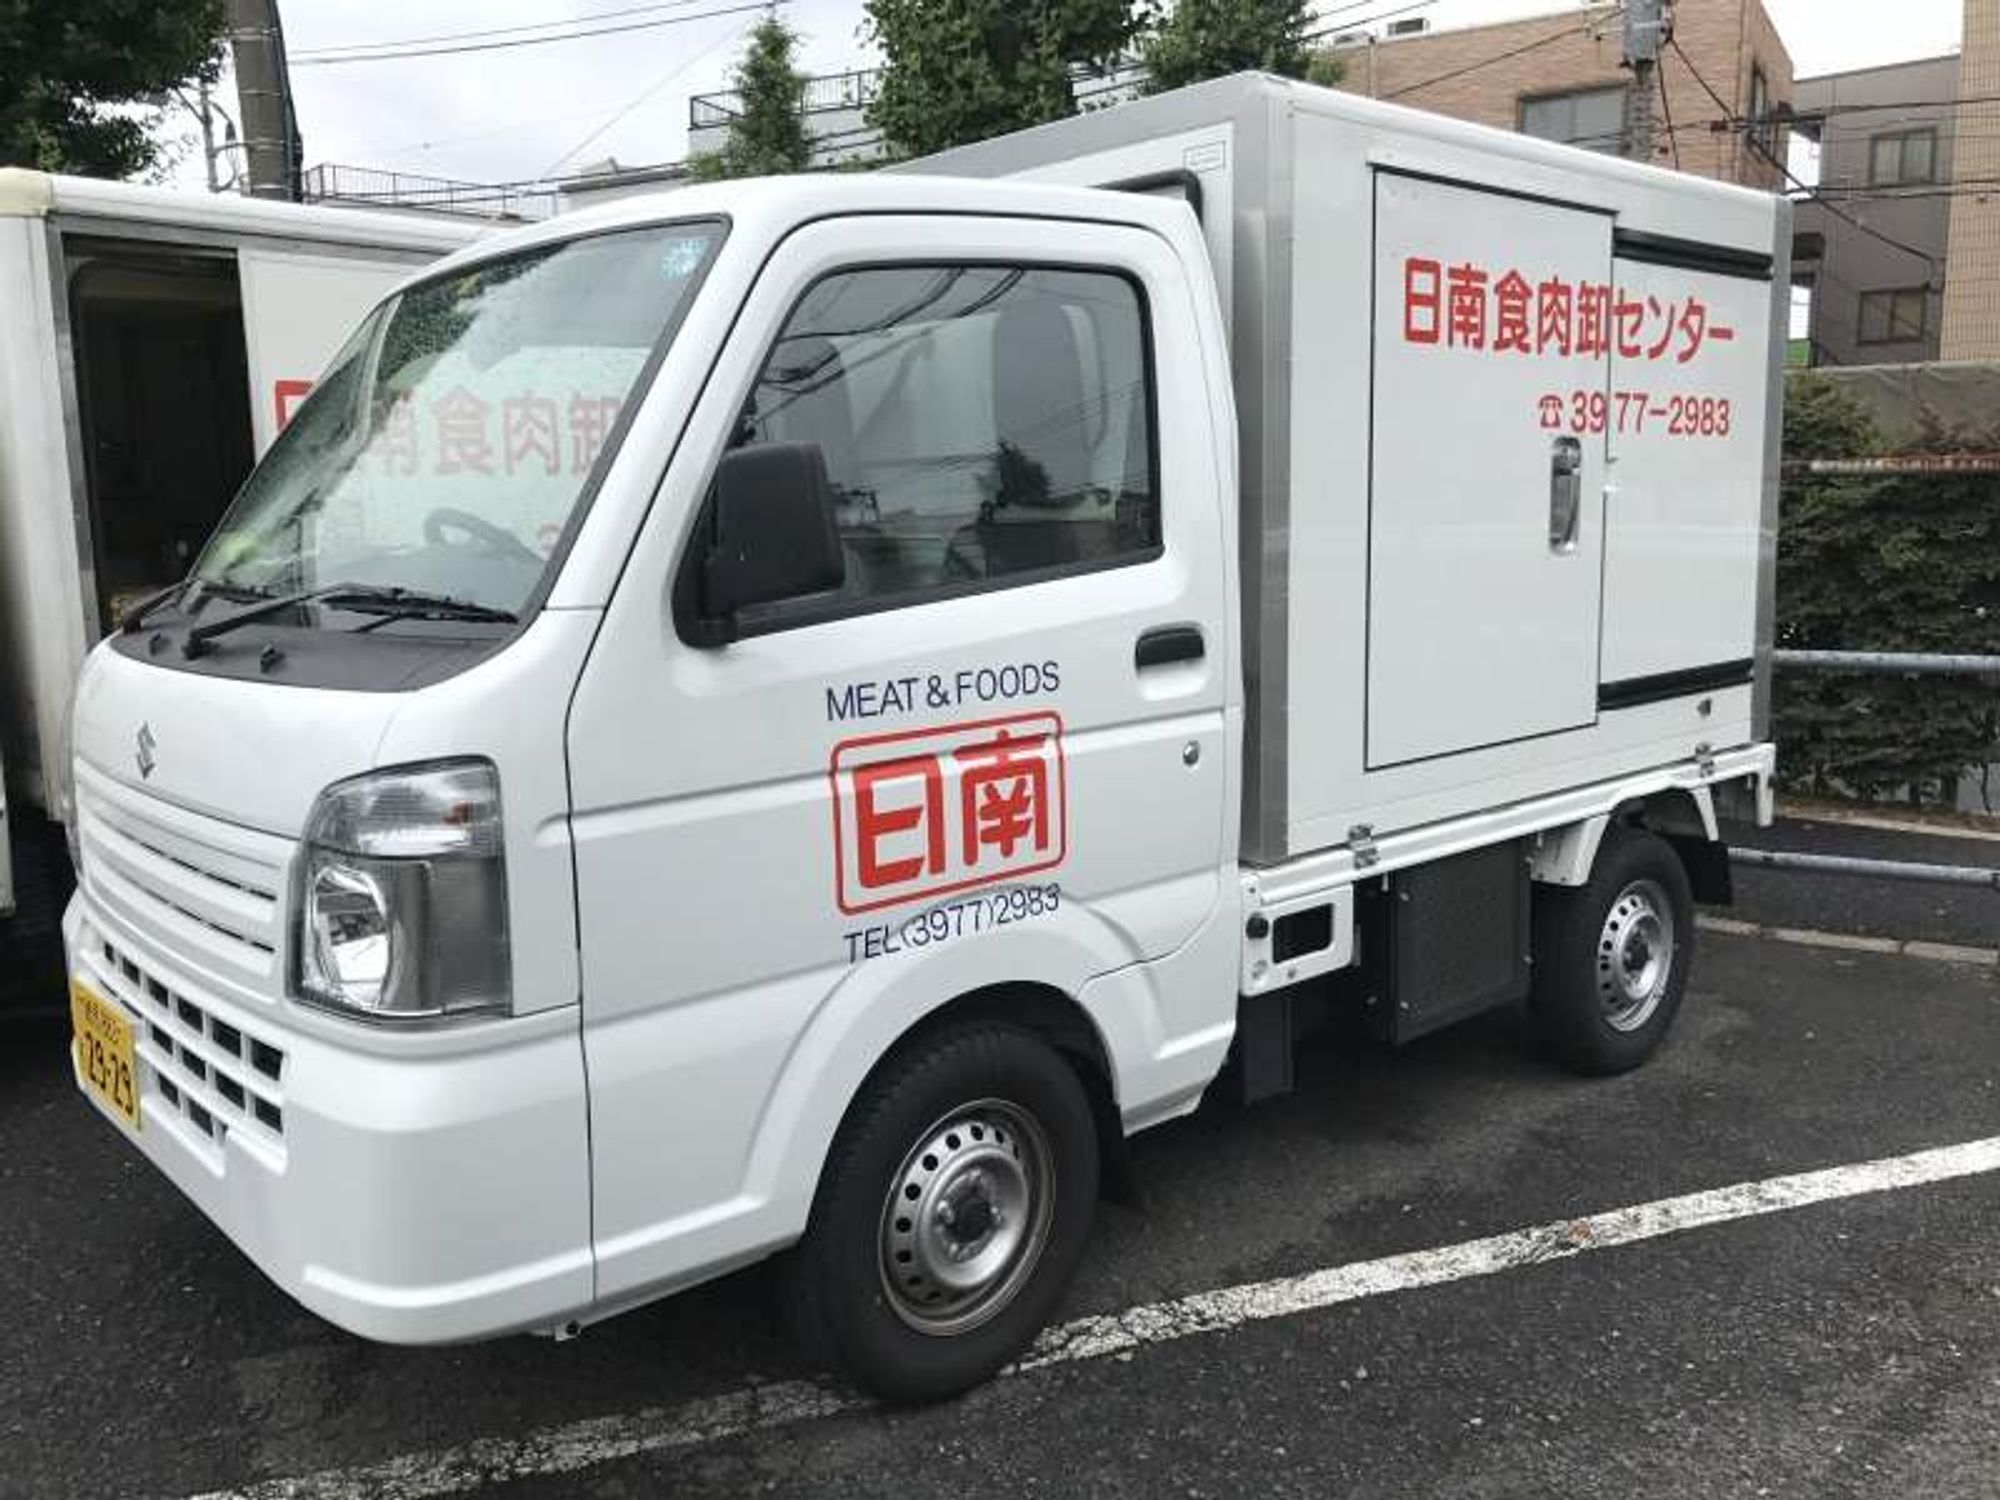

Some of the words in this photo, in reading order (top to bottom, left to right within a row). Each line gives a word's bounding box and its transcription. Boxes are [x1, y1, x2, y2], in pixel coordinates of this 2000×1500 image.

[1404, 257, 1734, 363] 日南食肉卸センター
[826, 677, 918, 722] MEAT
[927, 674, 950, 708] &
[955, 661, 1060, 704] FOODS
[853, 728, 1050, 889] 日南
